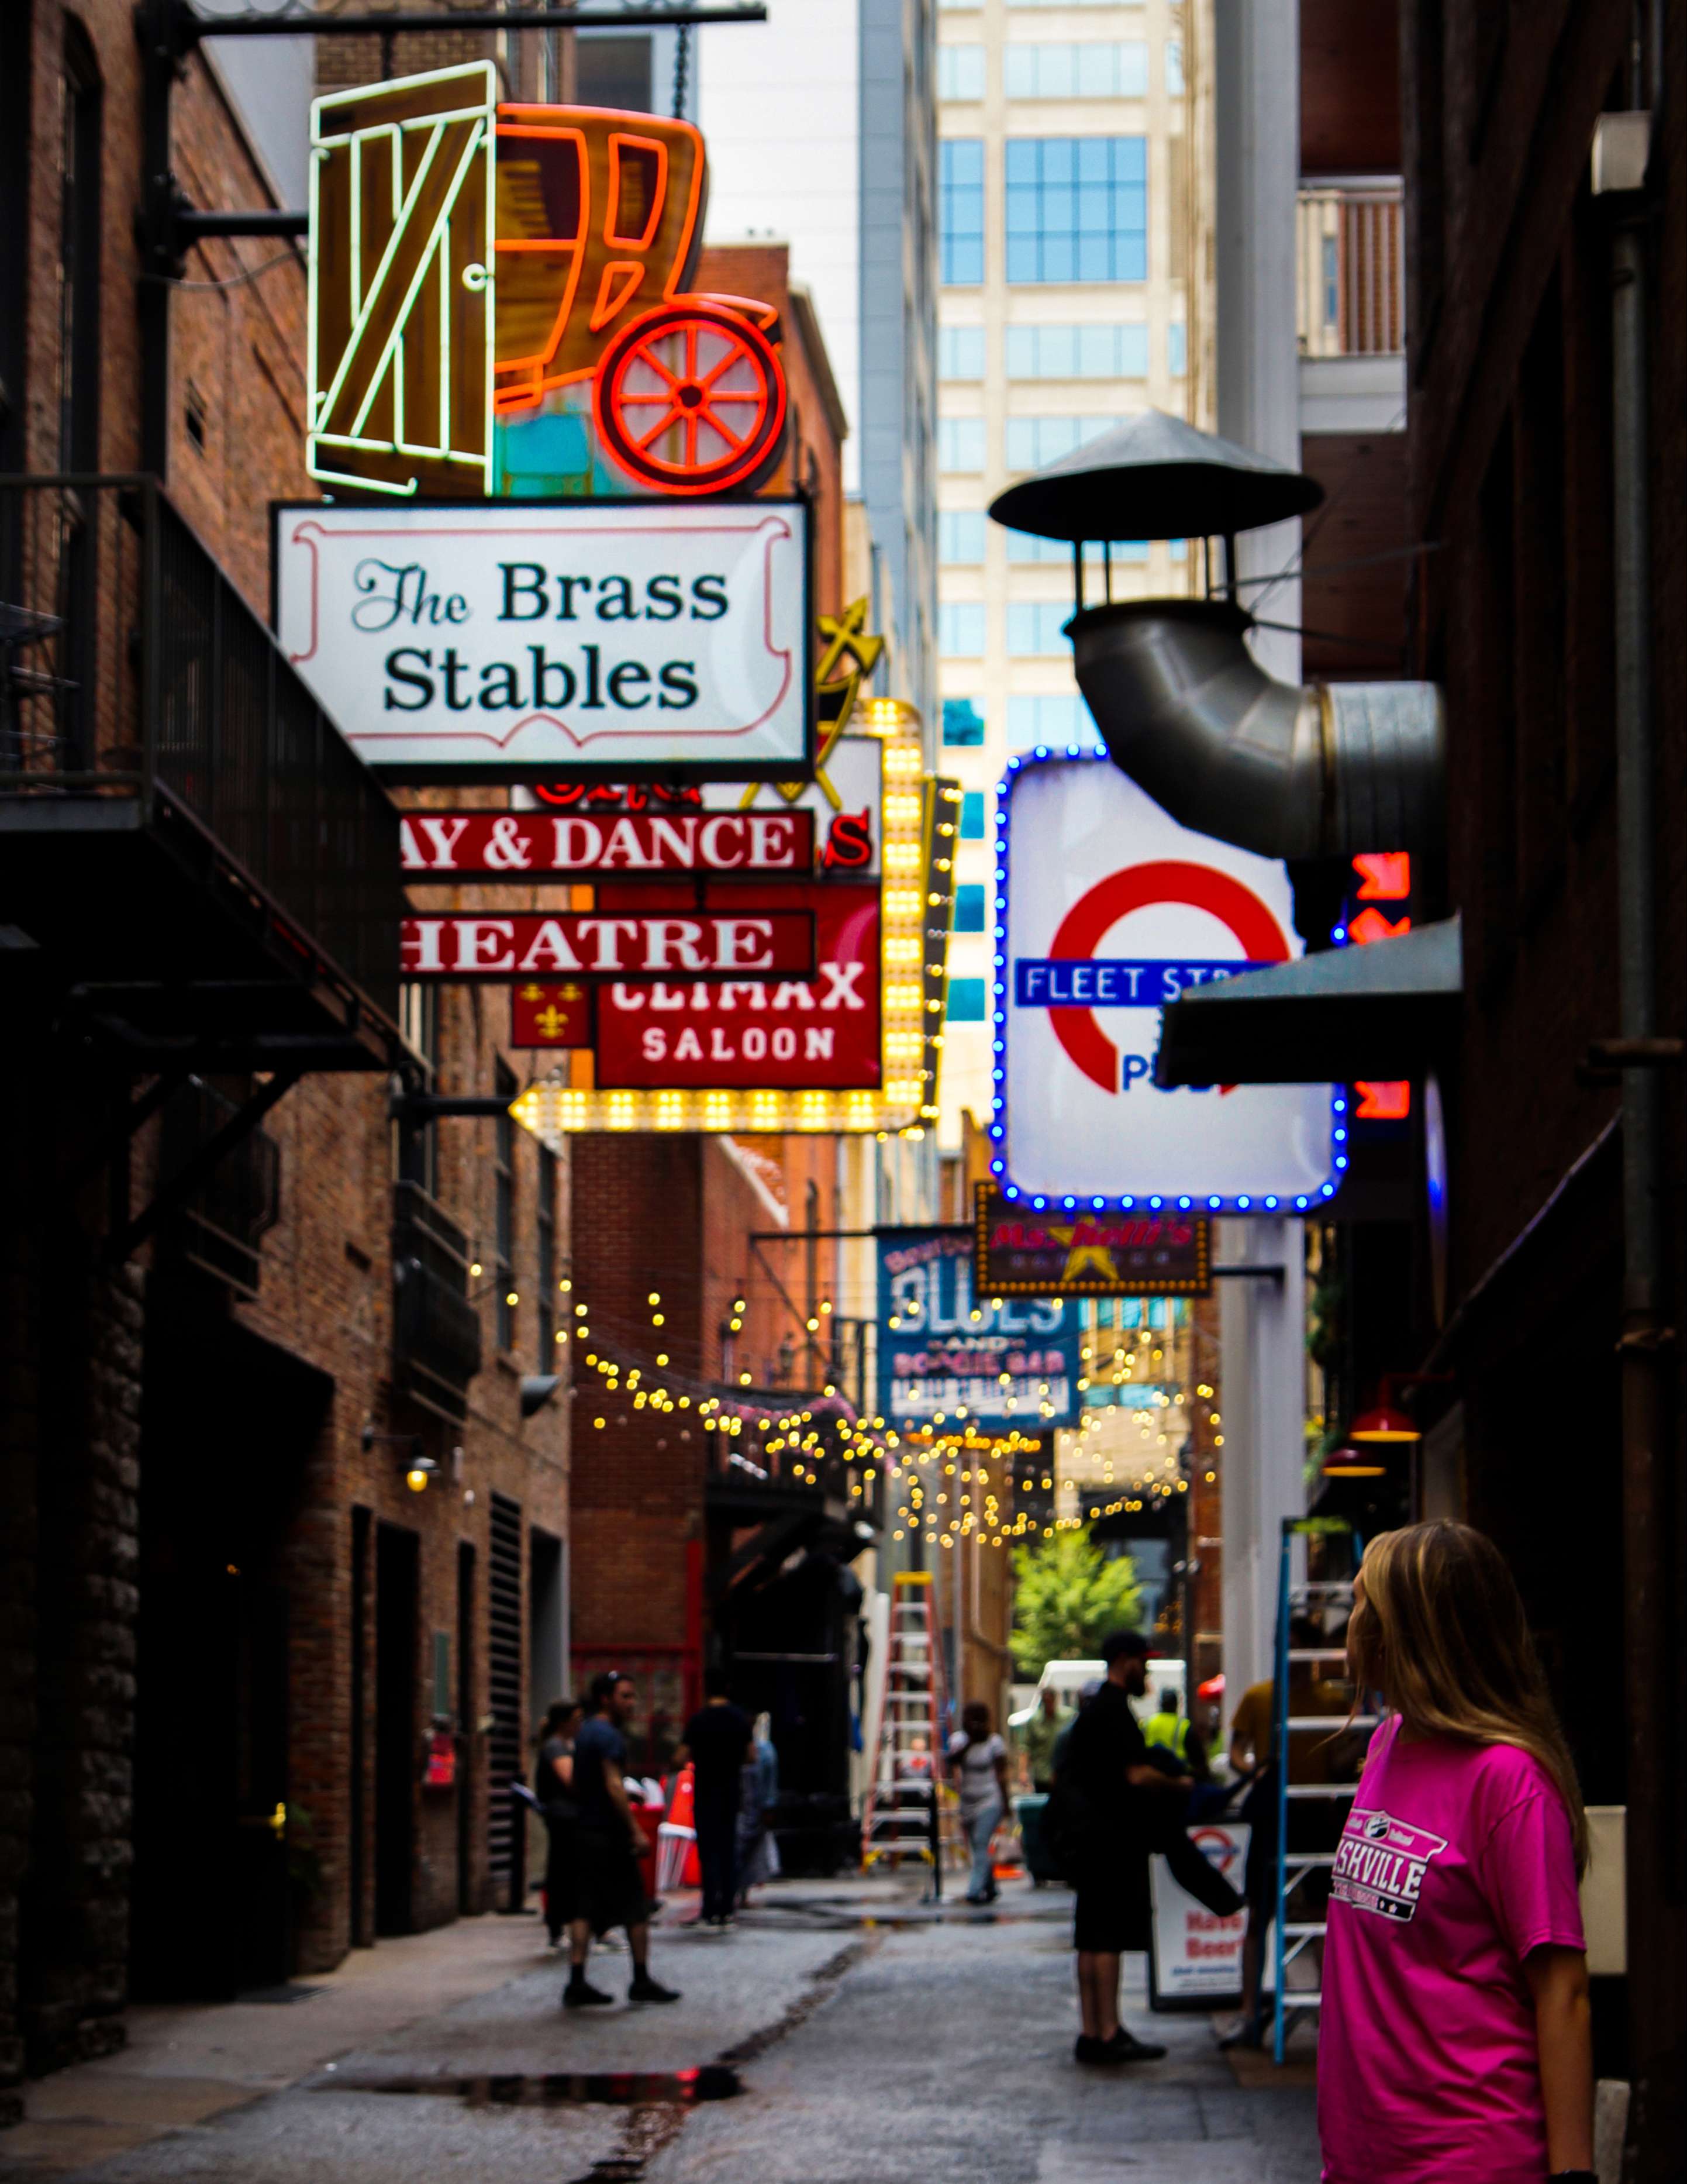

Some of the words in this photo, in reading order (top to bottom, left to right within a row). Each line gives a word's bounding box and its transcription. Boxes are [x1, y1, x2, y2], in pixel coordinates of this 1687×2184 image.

[352, 557, 470, 633] The
[496, 561, 729, 622] Brass
[384, 645, 699, 711] Stables
[483, 817, 533, 870] &
[551, 817, 794, 869] DANCE
[1027, 967, 1145, 999] FLEET
[643, 1027, 834, 1061] SALOON
[1332, 1839, 1427, 1900] SHVILLE
